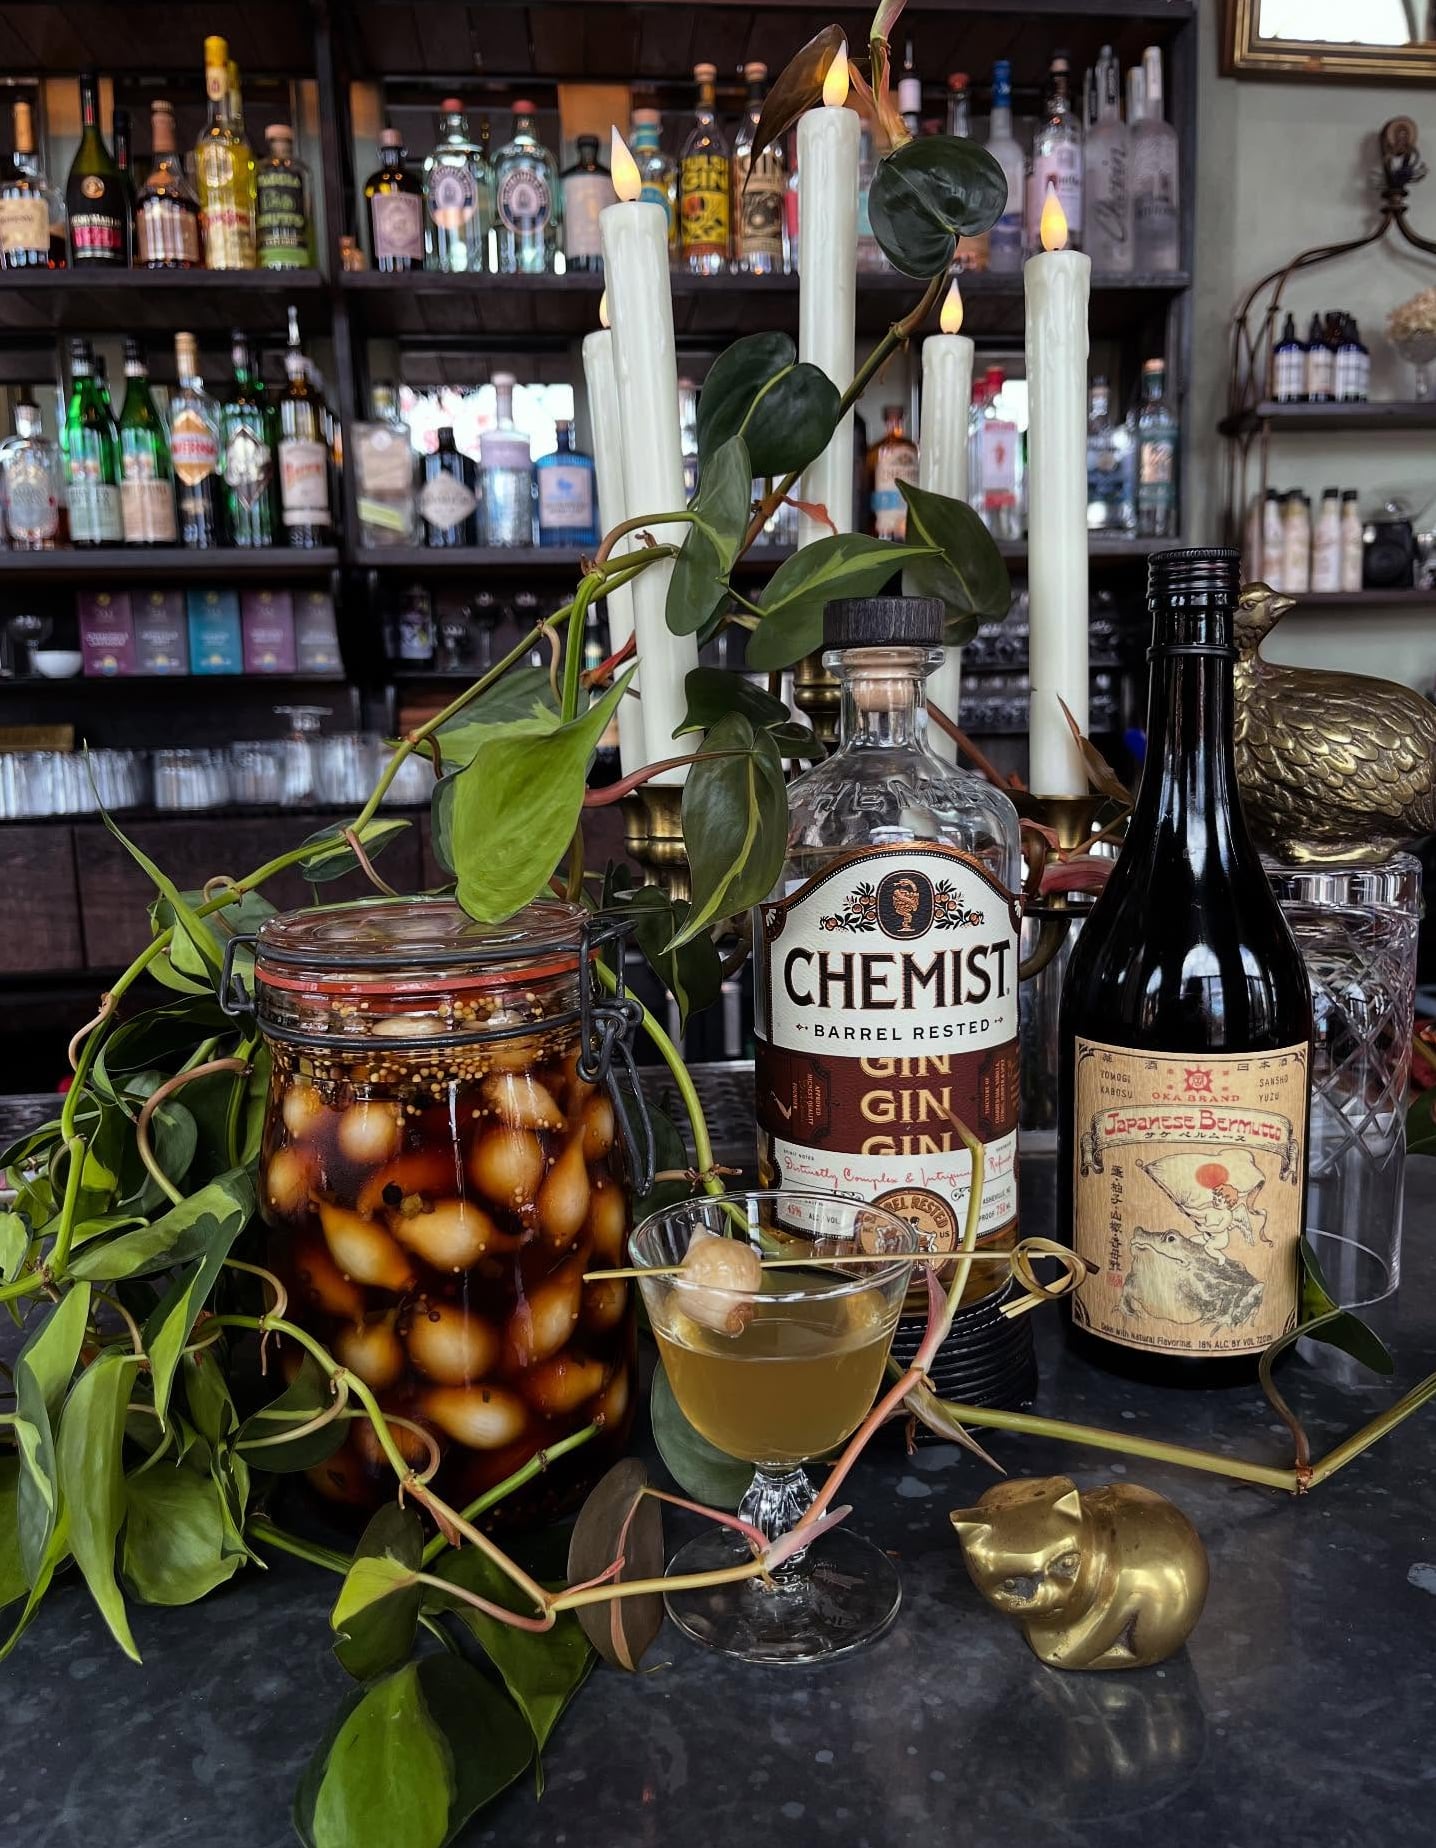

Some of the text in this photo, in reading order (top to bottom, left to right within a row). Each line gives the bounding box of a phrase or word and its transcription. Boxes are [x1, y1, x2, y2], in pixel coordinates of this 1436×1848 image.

[784, 939, 1011, 1010] CHEMIST
[814, 1018, 990, 1041] BARREL RESTED
[1259, 1074, 1289, 1088] SANSHO
[1100, 1085, 1133, 1099] KABOSU
[1151, 1091, 1240, 1103] OKA BRAND
[1258, 1092, 1280, 1104] YUZU
[859, 1086, 953, 1124] GIN
[1104, 1108, 1282, 1142] Japanese Bermutto
[843, 1166, 898, 1191] Complex
[911, 1195, 949, 1228] RESTED
[939, 1230, 951, 1238] US
[1231, 1339, 1241, 1348] BY
